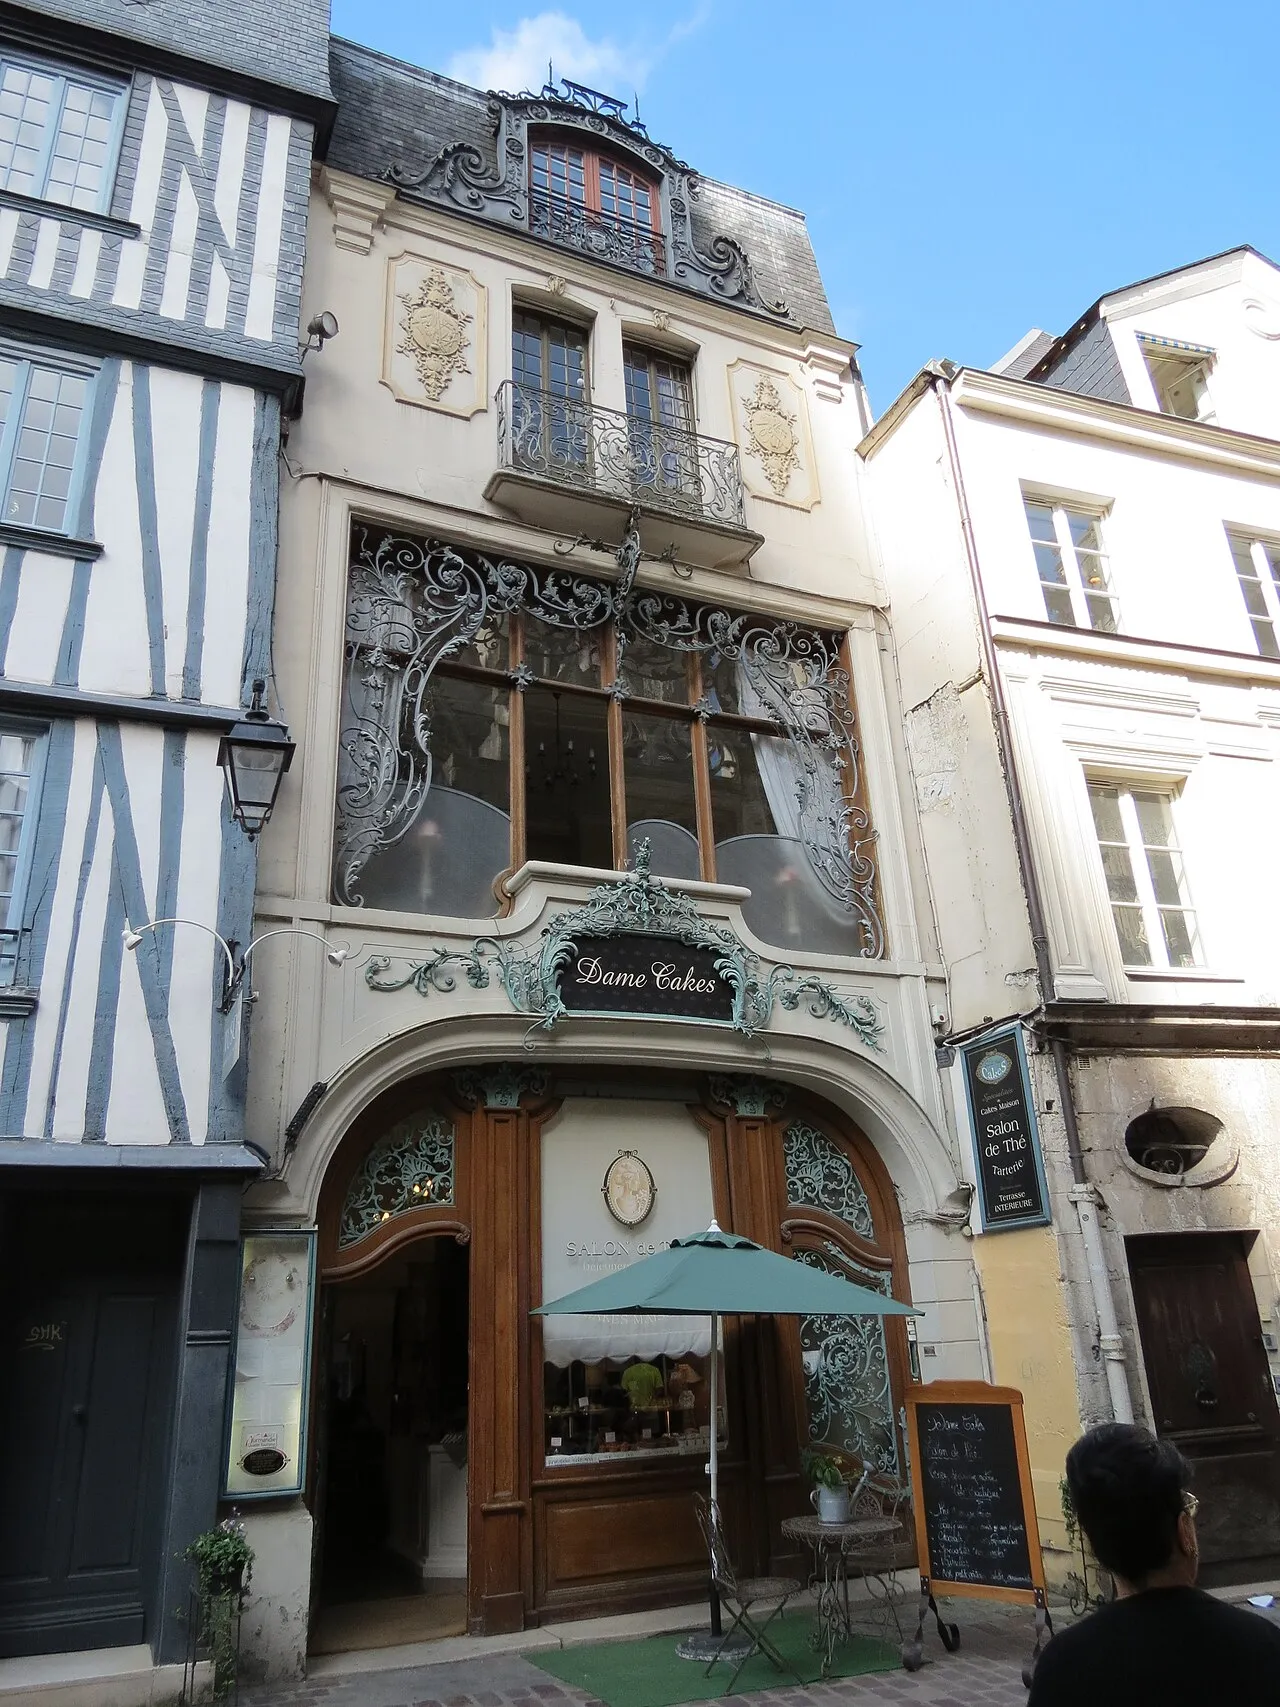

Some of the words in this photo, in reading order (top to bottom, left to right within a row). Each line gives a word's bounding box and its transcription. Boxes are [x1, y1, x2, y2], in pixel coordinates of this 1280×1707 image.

[575, 956, 647, 988] Dame
[651, 961, 716, 993] Cakes
[998, 1099, 1020, 1110] Maison
[986, 1118, 1020, 1139] Salon
[985, 1142, 1000, 1158] de
[1002, 1133, 1027, 1154] Thé
[991, 1157, 1024, 1177] Tarterie
[994, 1198, 1033, 1213] INTERIEURE
[998, 1191, 1026, 1203] Terrasse
[565, 1241, 630, 1257] SALON
[636, 1241, 656, 1256] de
